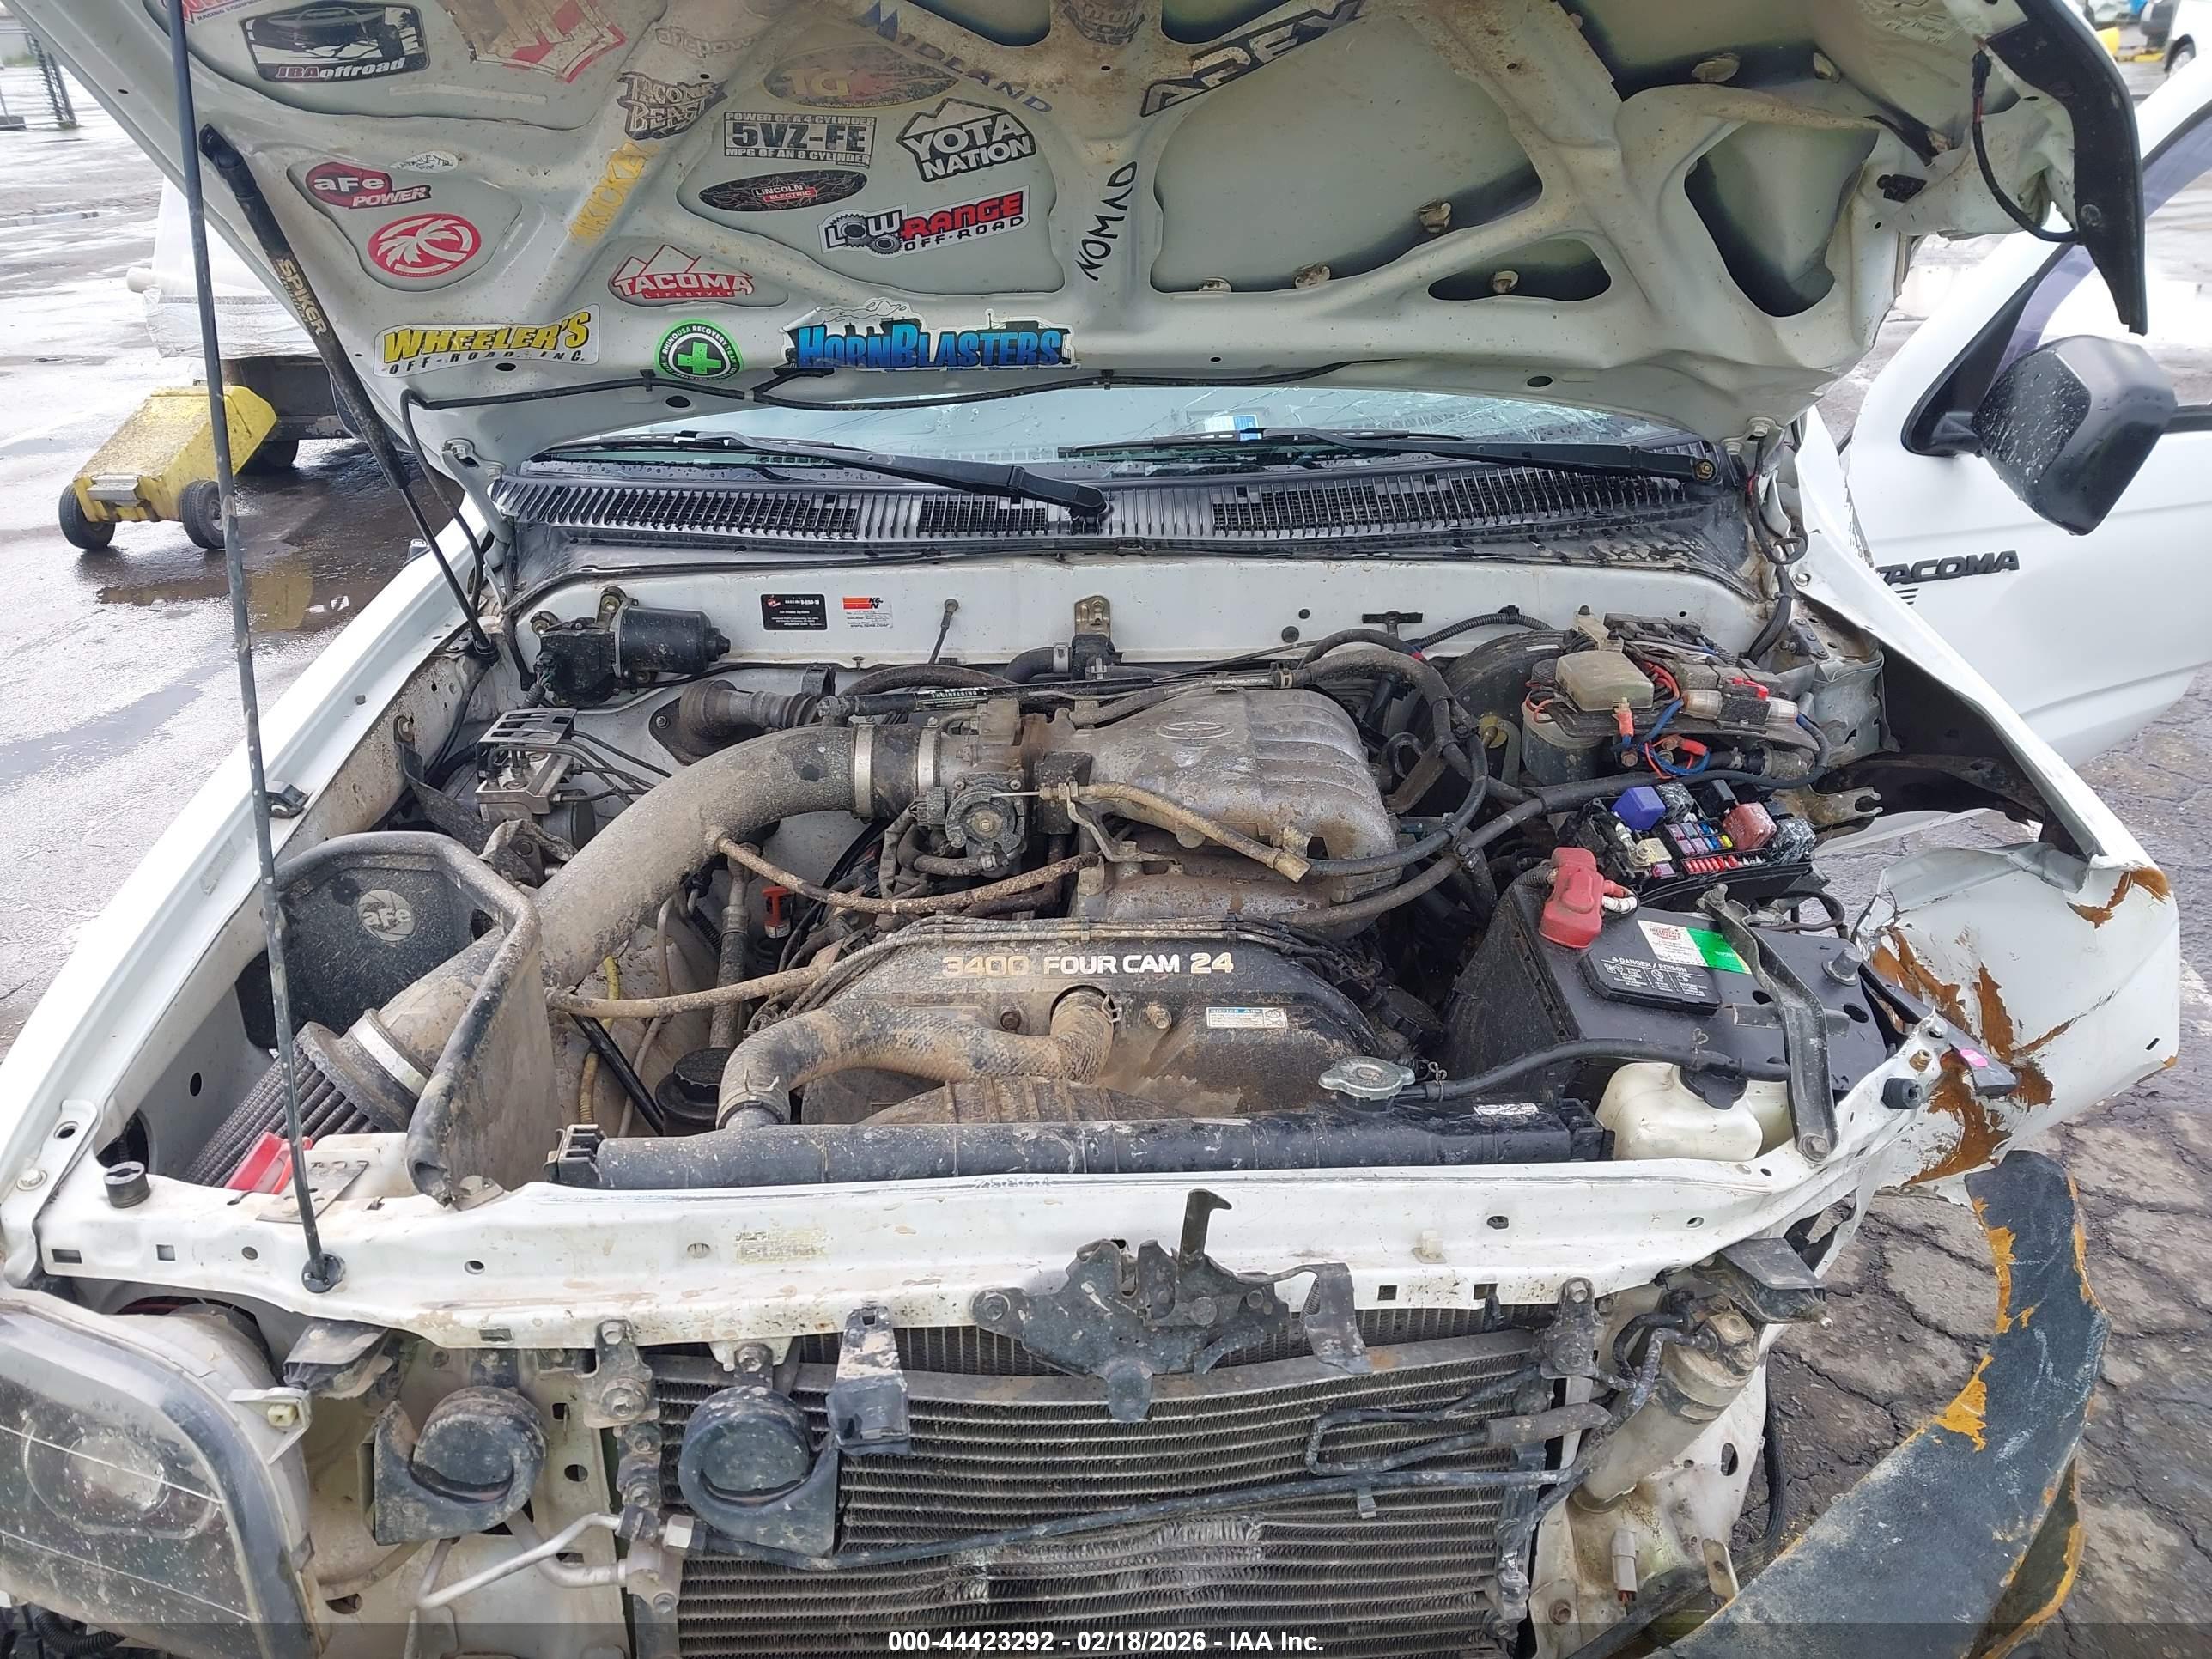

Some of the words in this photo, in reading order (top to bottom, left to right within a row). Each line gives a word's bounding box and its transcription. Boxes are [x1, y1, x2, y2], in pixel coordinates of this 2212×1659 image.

[726, 112, 772, 122] POWER
[775, 113, 792, 122] OF
[793, 114, 803, 123] A
[804, 114, 812, 123] 4
[815, 116, 875, 125] CYLINDER
[732, 122, 867, 152] 5VZ-FE
[902, 114, 1026, 161] YOTA
[726, 149, 756, 157] MPG
[809, 151, 871, 164] CYLINDER
[921, 136, 1036, 179] NATION
[313, 177, 386, 192] aFe
[352, 186, 427, 207] POWER
[755, 184, 804, 196] LINCOLN
[769, 191, 811, 201] ELECTRIC
[903, 216, 1024, 252] OFF-ROAD
[1075, 161, 1138, 282] NOMAD
[613, 272, 755, 297] TACOMA
[383, 312, 592, 364] WHEELER'S
[1875, 550, 2020, 586] TACOMA
[942, 956, 1030, 977] 3400
[1043, 955, 1116, 975] FOUR
[1122, 955, 1180, 974] CAM
[1190, 952, 1234, 975] 24
[1619, 957, 1652, 969] DANGER
[1658, 963, 1688, 973] POISON
